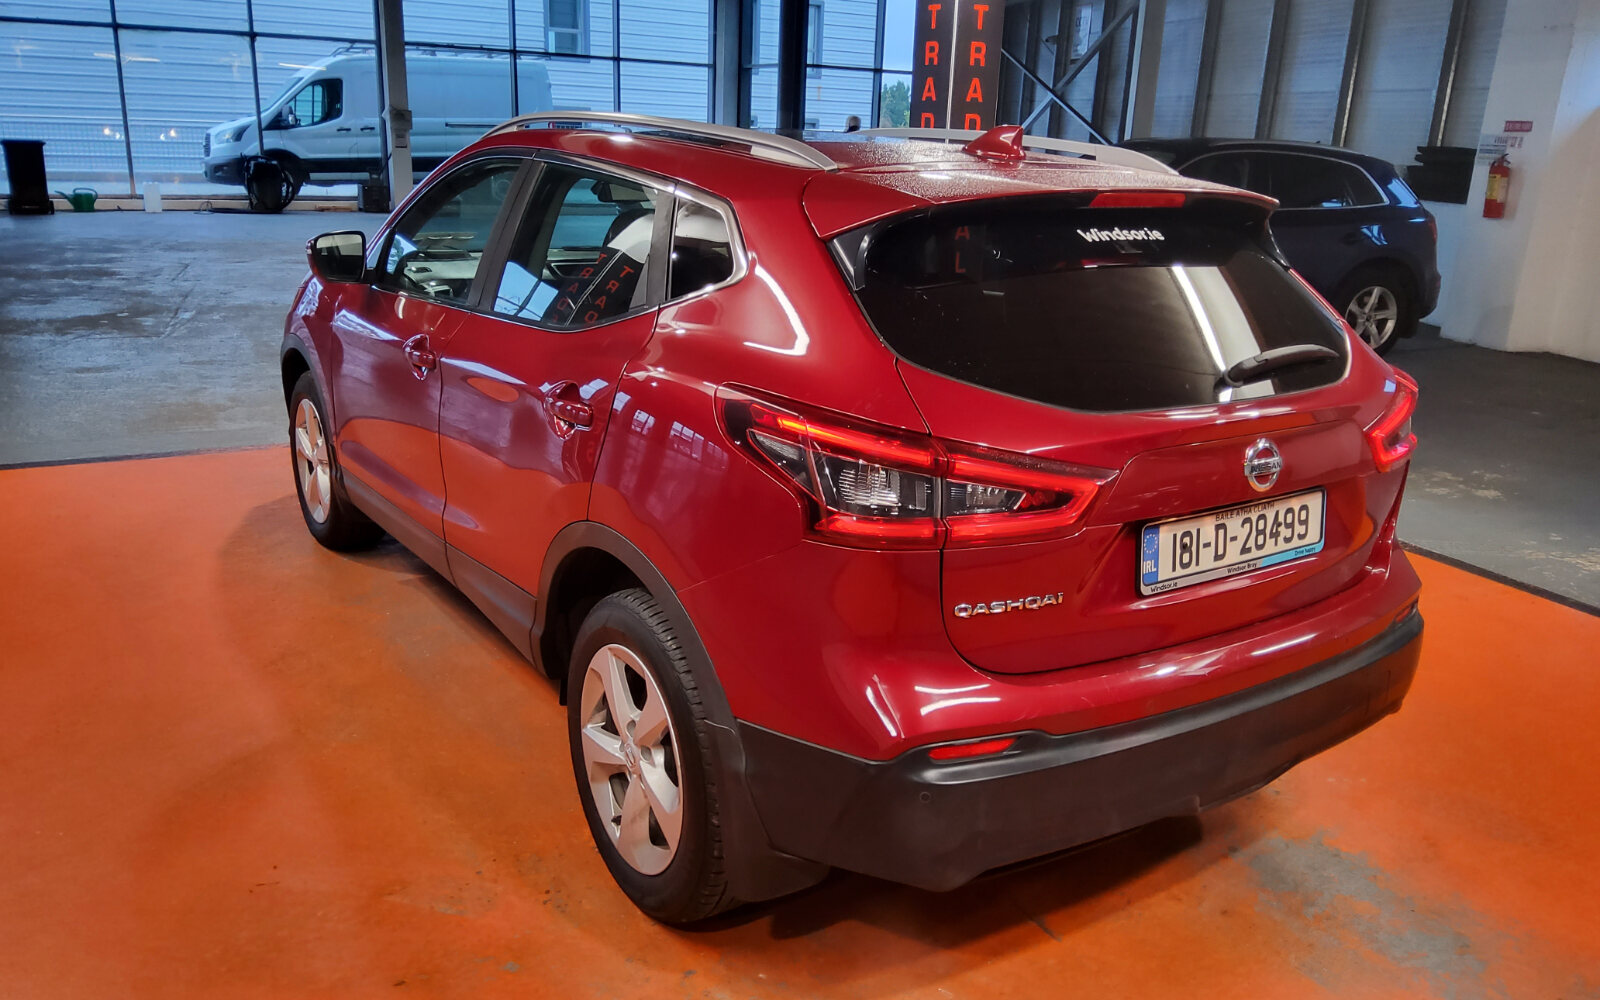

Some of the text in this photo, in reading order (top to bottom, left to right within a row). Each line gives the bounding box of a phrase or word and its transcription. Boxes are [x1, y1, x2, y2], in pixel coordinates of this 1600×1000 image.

[1076, 227, 1165, 242] Windsor.ie
[1215, 511, 1234, 522] BAILE
[1171, 503, 1310, 573] 181-D-28499
[1143, 560, 1157, 574] IRL
